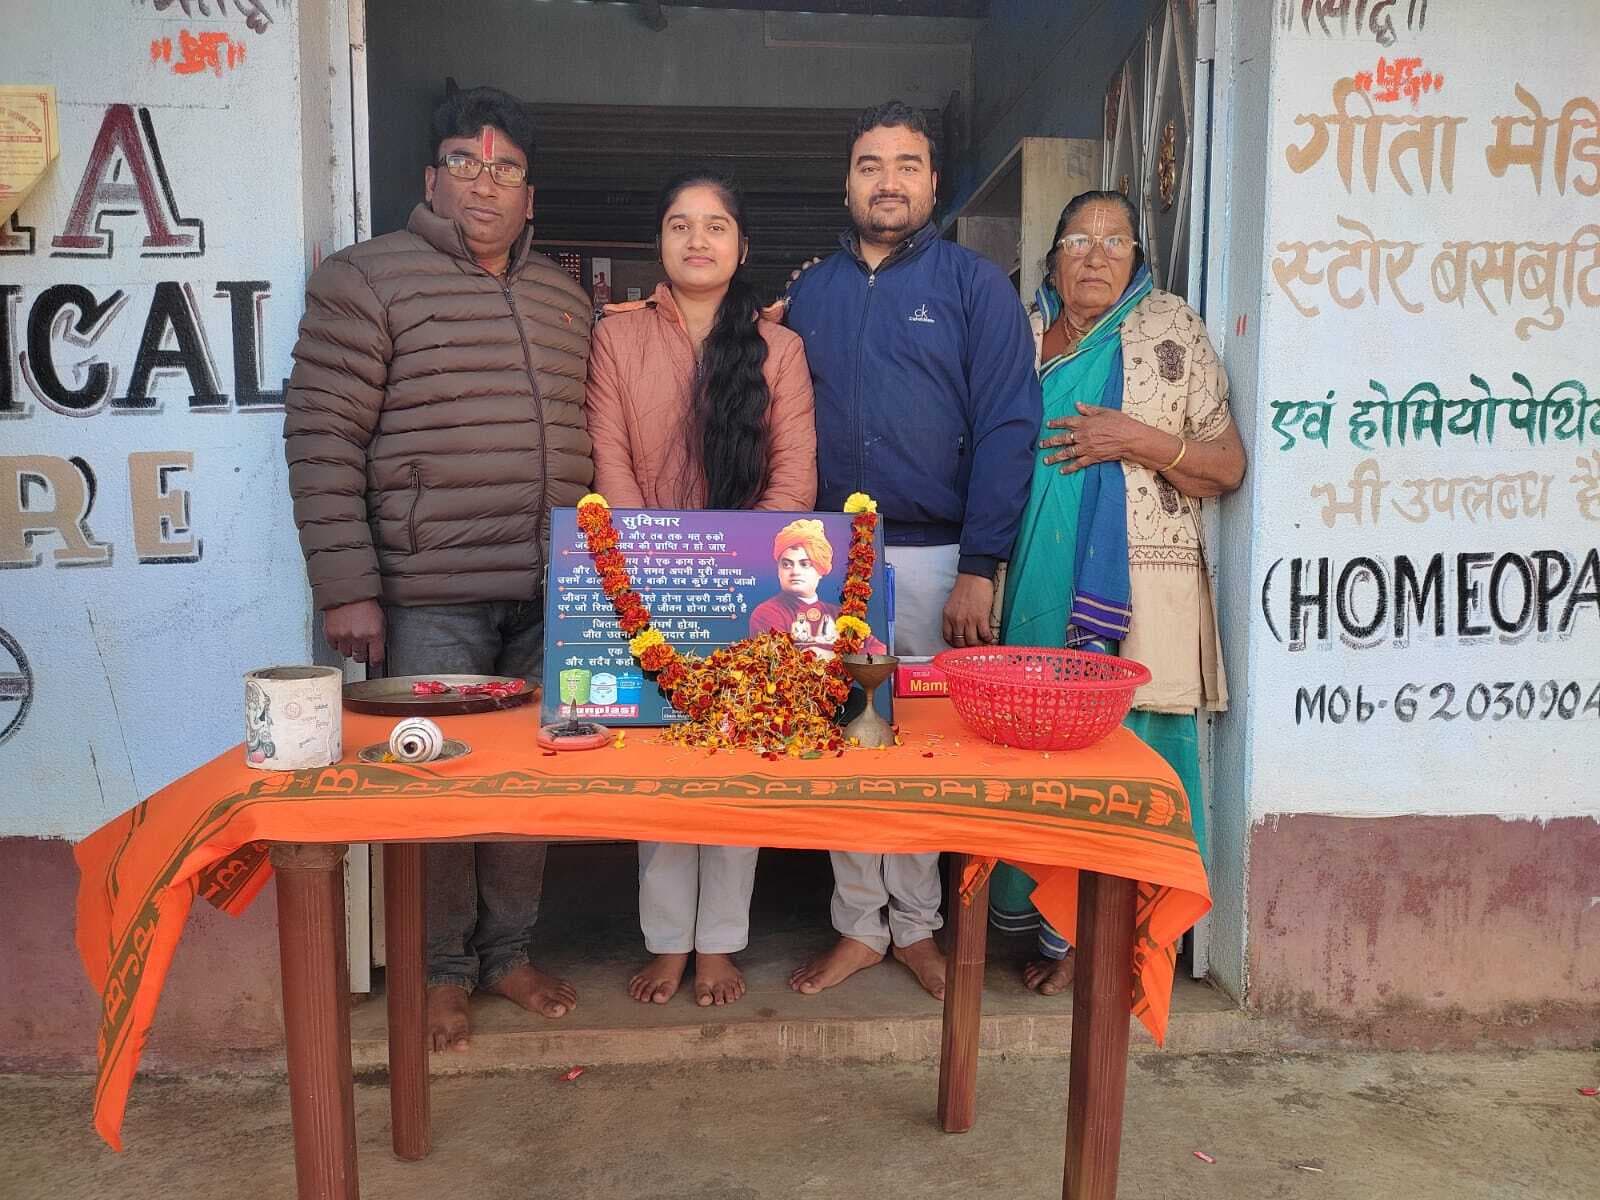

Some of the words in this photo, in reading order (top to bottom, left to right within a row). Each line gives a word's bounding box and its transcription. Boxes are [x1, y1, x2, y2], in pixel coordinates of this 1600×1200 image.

[1286, 77, 1468, 195] गीता
[1272, 215, 1424, 317] स्टोर
[1271, 390, 1335, 451] एवं
[1311, 458, 1390, 528] भी
[622, 514, 680, 529] सुविचार
[629, 531, 645, 540] और
[667, 533, 682, 541] तक
[688, 533, 701, 541] मत
[638, 540, 651, 550] की
[682, 543, 689, 551] न
[694, 541, 704, 551] हो
[708, 543, 727, 552] जाए
[625, 557, 638, 566] मय
[656, 558, 670, 567] एक
[676, 558, 693, 566] काम
[572, 564, 591, 575] और
[669, 565, 693, 576] अपनी
[646, 575, 667, 585] बाकी
[560, 592, 587, 602] जीवन
[661, 592, 681, 602] होना
[715, 592, 732, 603] नहीं
[736, 593, 744, 604] है
[558, 604, 570, 612] पर
[574, 602, 587, 612] जो
[592, 602, 614, 612] रिश्ते
[657, 602, 682, 613] जीवन
[687, 602, 707, 613] होना
[582, 628, 602, 639] जीत
[689, 629, 711, 640] होगी
[608, 647, 624, 657] एक
[565, 656, 584, 667] और
[859, 779, 978, 799] BJP
[1031, 780, 1143, 820] BJP
